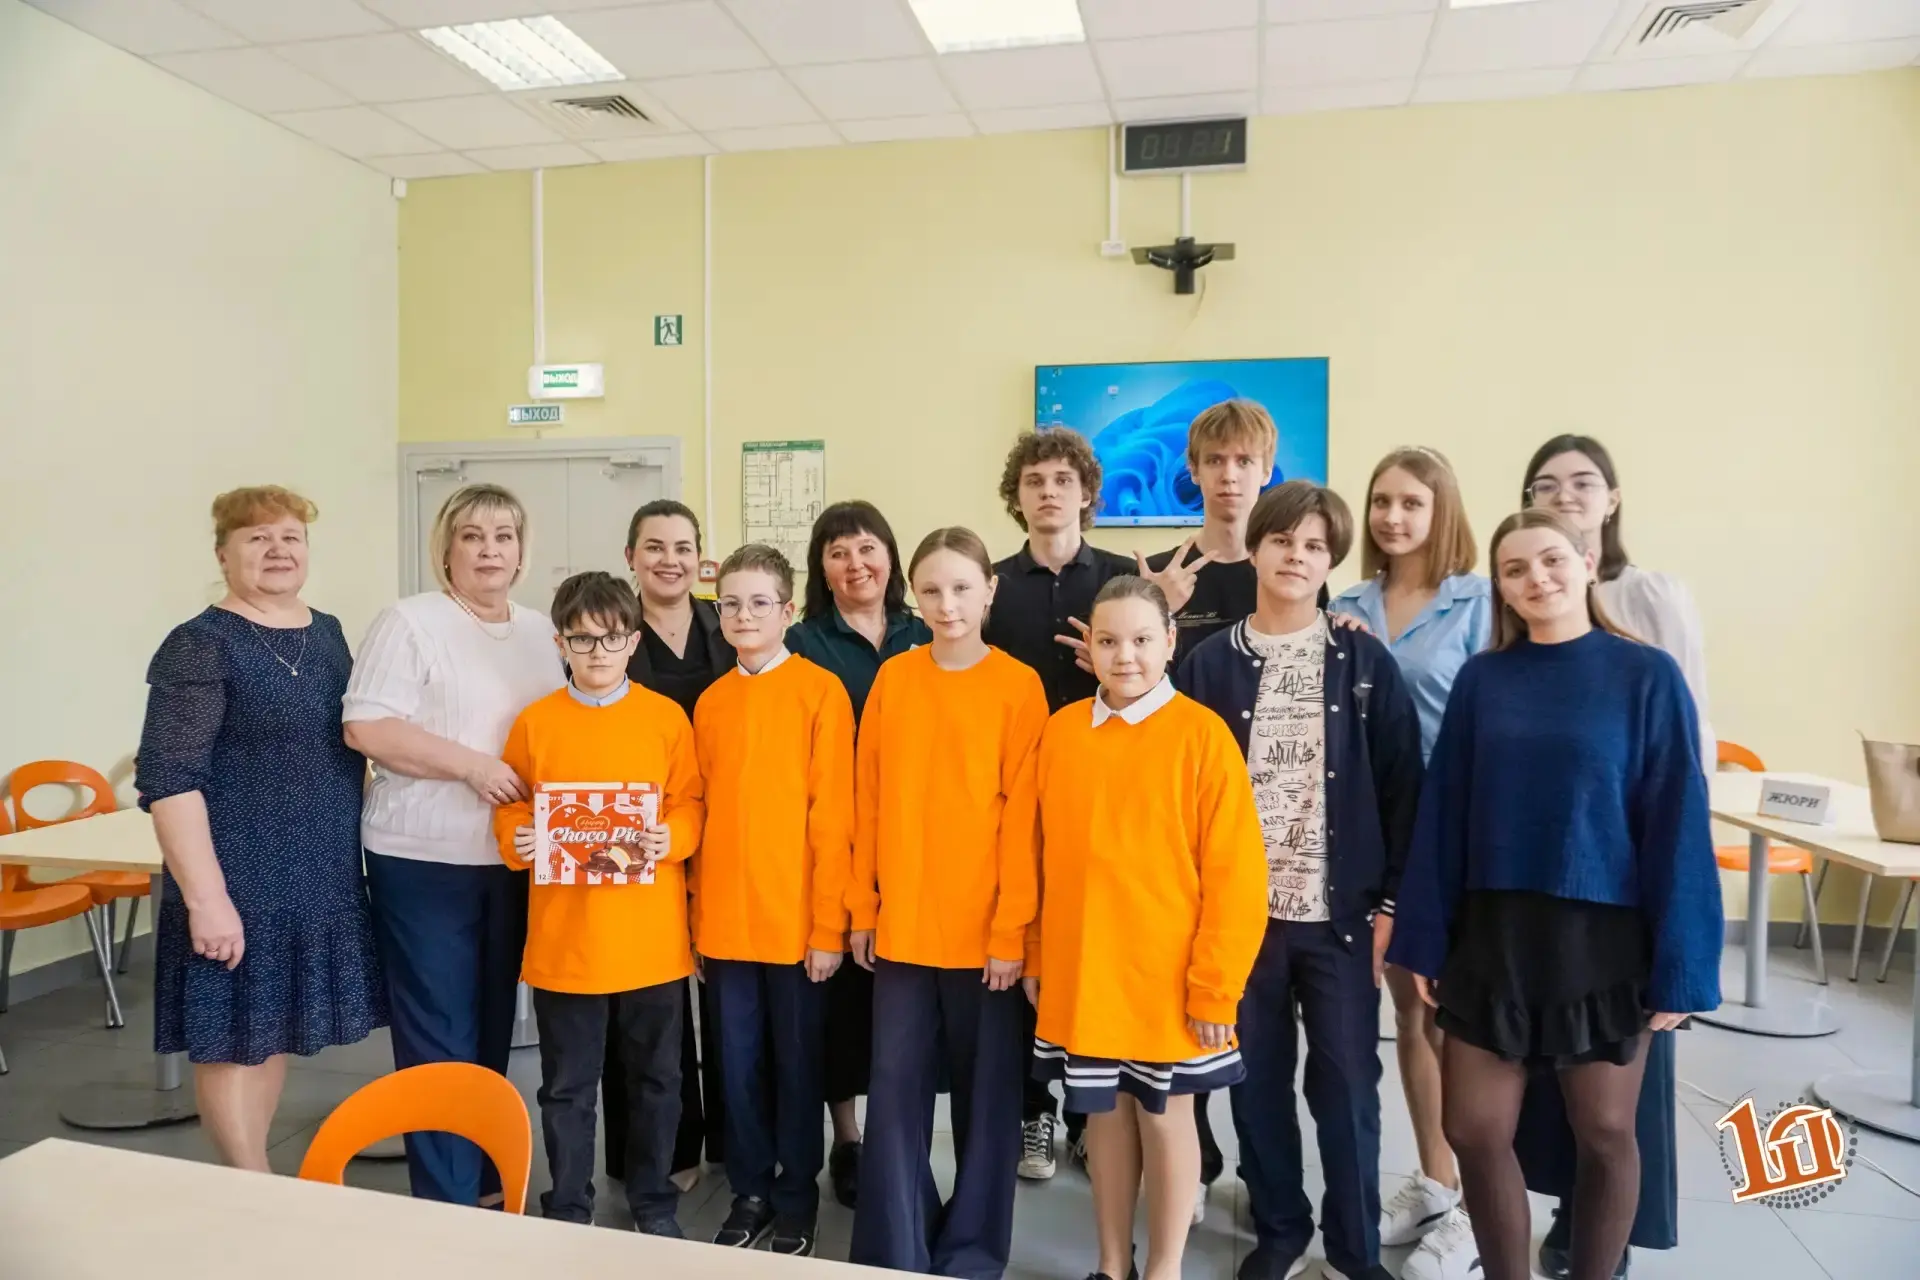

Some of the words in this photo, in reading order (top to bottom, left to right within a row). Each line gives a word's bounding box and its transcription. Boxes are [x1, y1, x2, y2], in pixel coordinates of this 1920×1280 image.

[1767, 791, 1821, 809] ЖЮРИ
[548, 827, 608, 843] Choco
[608, 827, 641, 843] Pie
